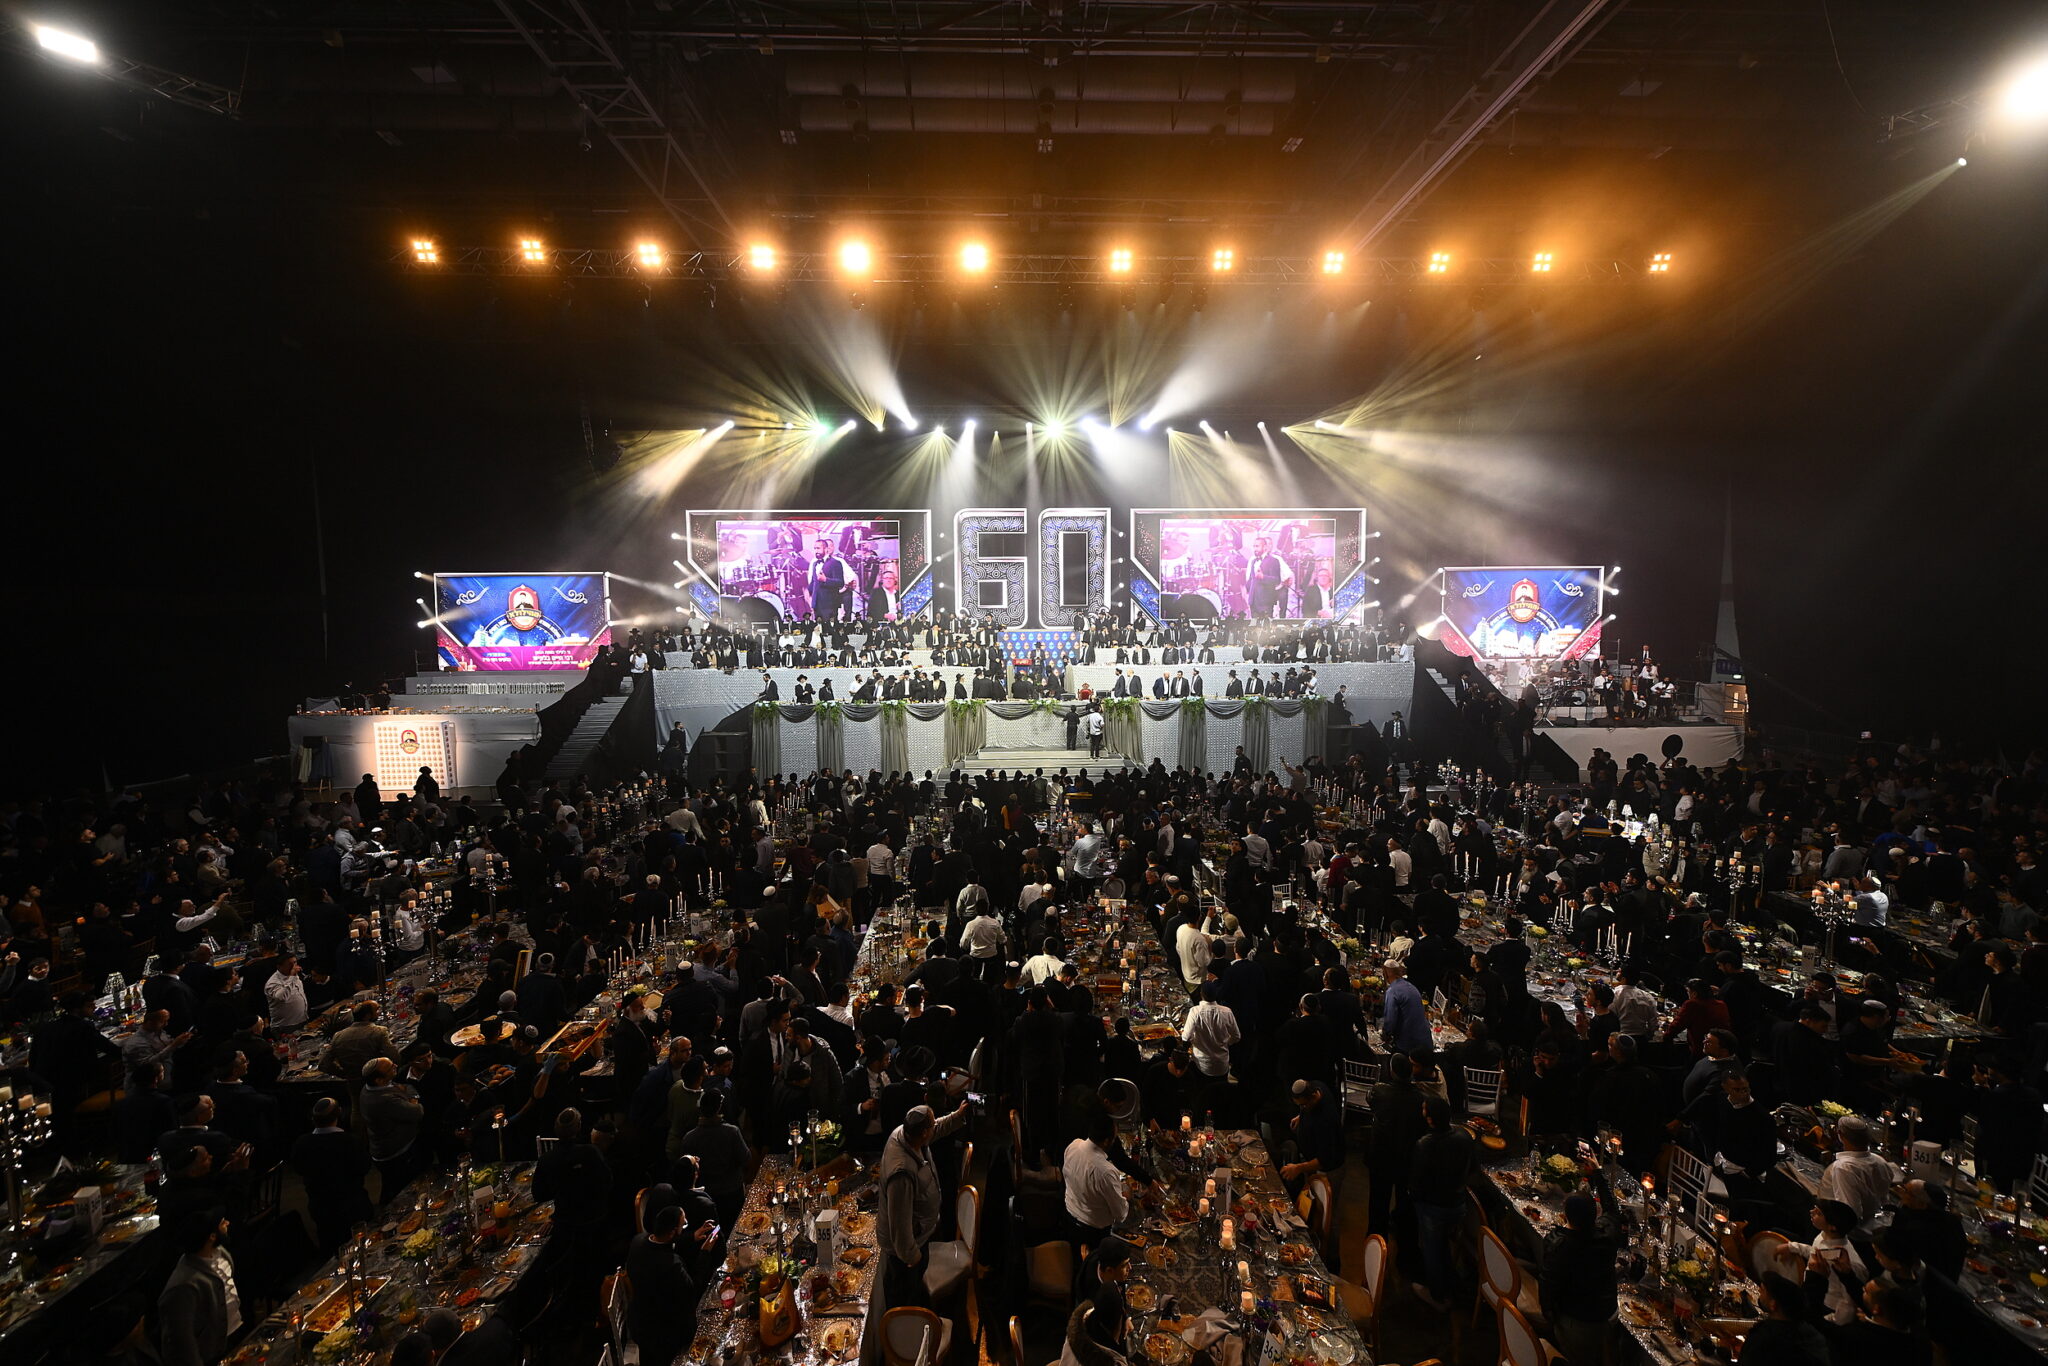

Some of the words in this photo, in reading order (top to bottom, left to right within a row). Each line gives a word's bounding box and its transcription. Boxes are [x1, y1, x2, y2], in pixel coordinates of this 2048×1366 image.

[954, 507, 1112, 630] 60
[1913, 1150, 1930, 1164] 361
[817, 1228, 831, 1241] 365
